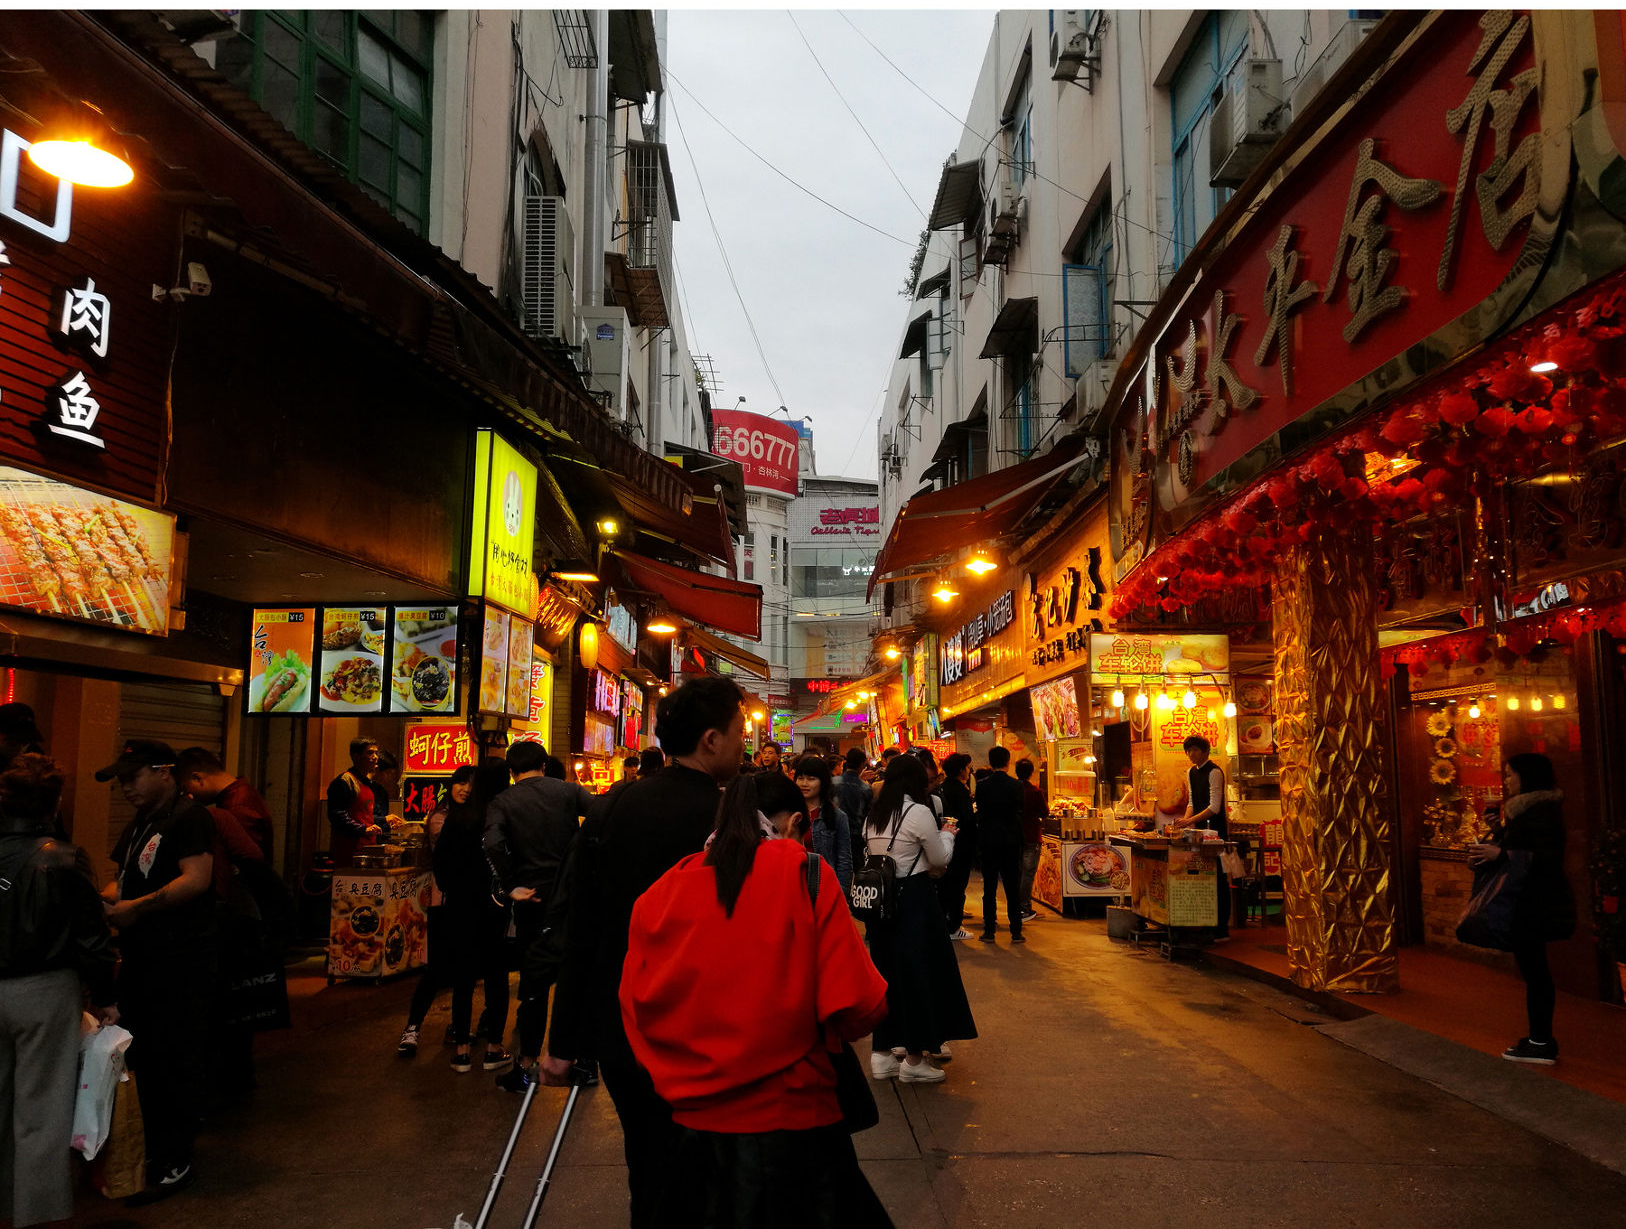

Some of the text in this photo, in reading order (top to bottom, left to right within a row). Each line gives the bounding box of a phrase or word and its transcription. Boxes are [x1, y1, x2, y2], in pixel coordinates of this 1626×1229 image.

[61, 277, 110, 358] 肉
[48, 371, 106, 449] 鱼
[1112, 638, 1151, 655] 台湾
[1098, 653, 1163, 673] 车轮饼
[1172, 704, 1209, 724] 台湾
[409, 732, 473, 765] 蚵仔煎
[349, 882, 382, 896] 臭豆腐
[851, 885, 878, 900] GOOD
[853, 897, 873, 909] GIRL
